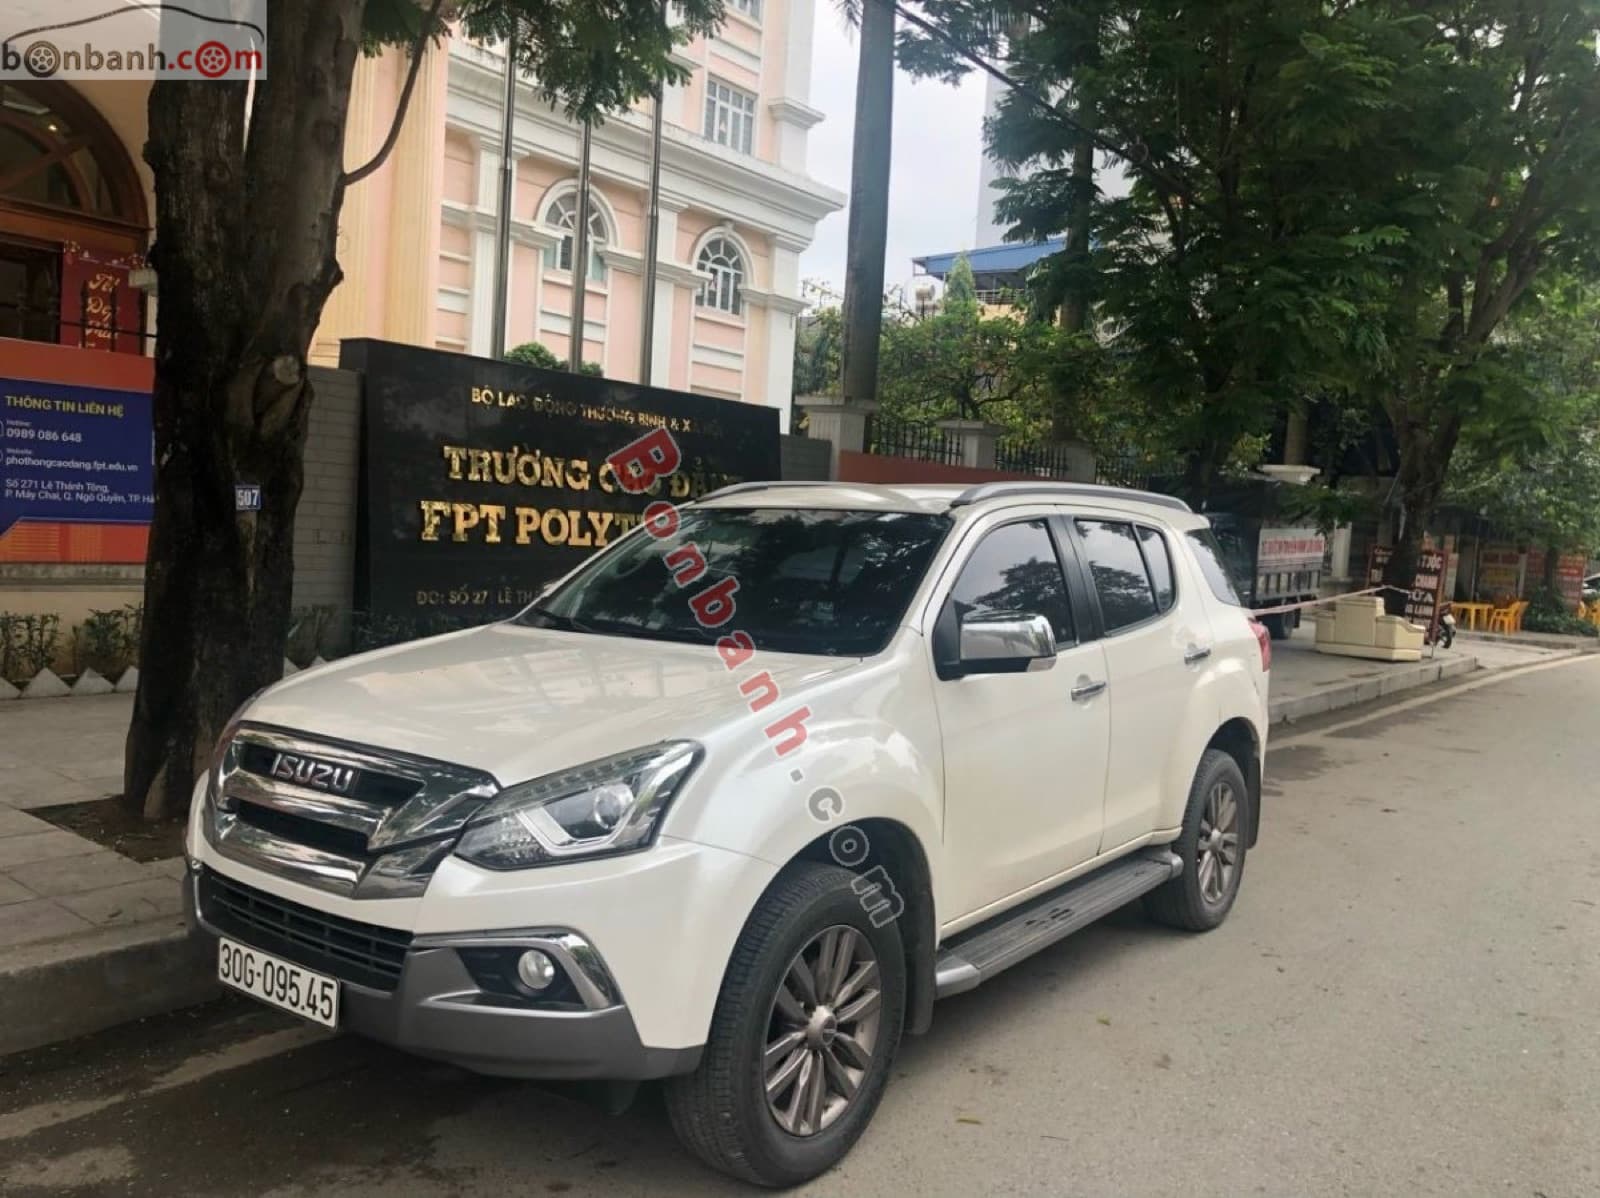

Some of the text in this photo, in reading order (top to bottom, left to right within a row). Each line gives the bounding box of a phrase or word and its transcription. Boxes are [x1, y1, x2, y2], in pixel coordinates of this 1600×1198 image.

[5, 395, 125, 418] THÔNG TIN LIÊN HỆ
[471, 386, 495, 410] BỘ
[670, 416, 680, 431] &
[6, 428, 82, 443] 0989 086 648
[6, 456, 139, 472] phothongcaodang.fpt.edu.vn
[443, 444, 590, 491] TRƯỜNG
[6, 478, 20, 489] Số
[21, 480, 38, 490] 271
[41, 481, 53, 490] Lê
[238, 489, 258, 506] 507
[420, 500, 506, 543] FPT
[449, 584, 469, 605] SỐ
[270, 752, 353, 793] ISUZU
[219, 943, 336, 1021] 30G-095.45
